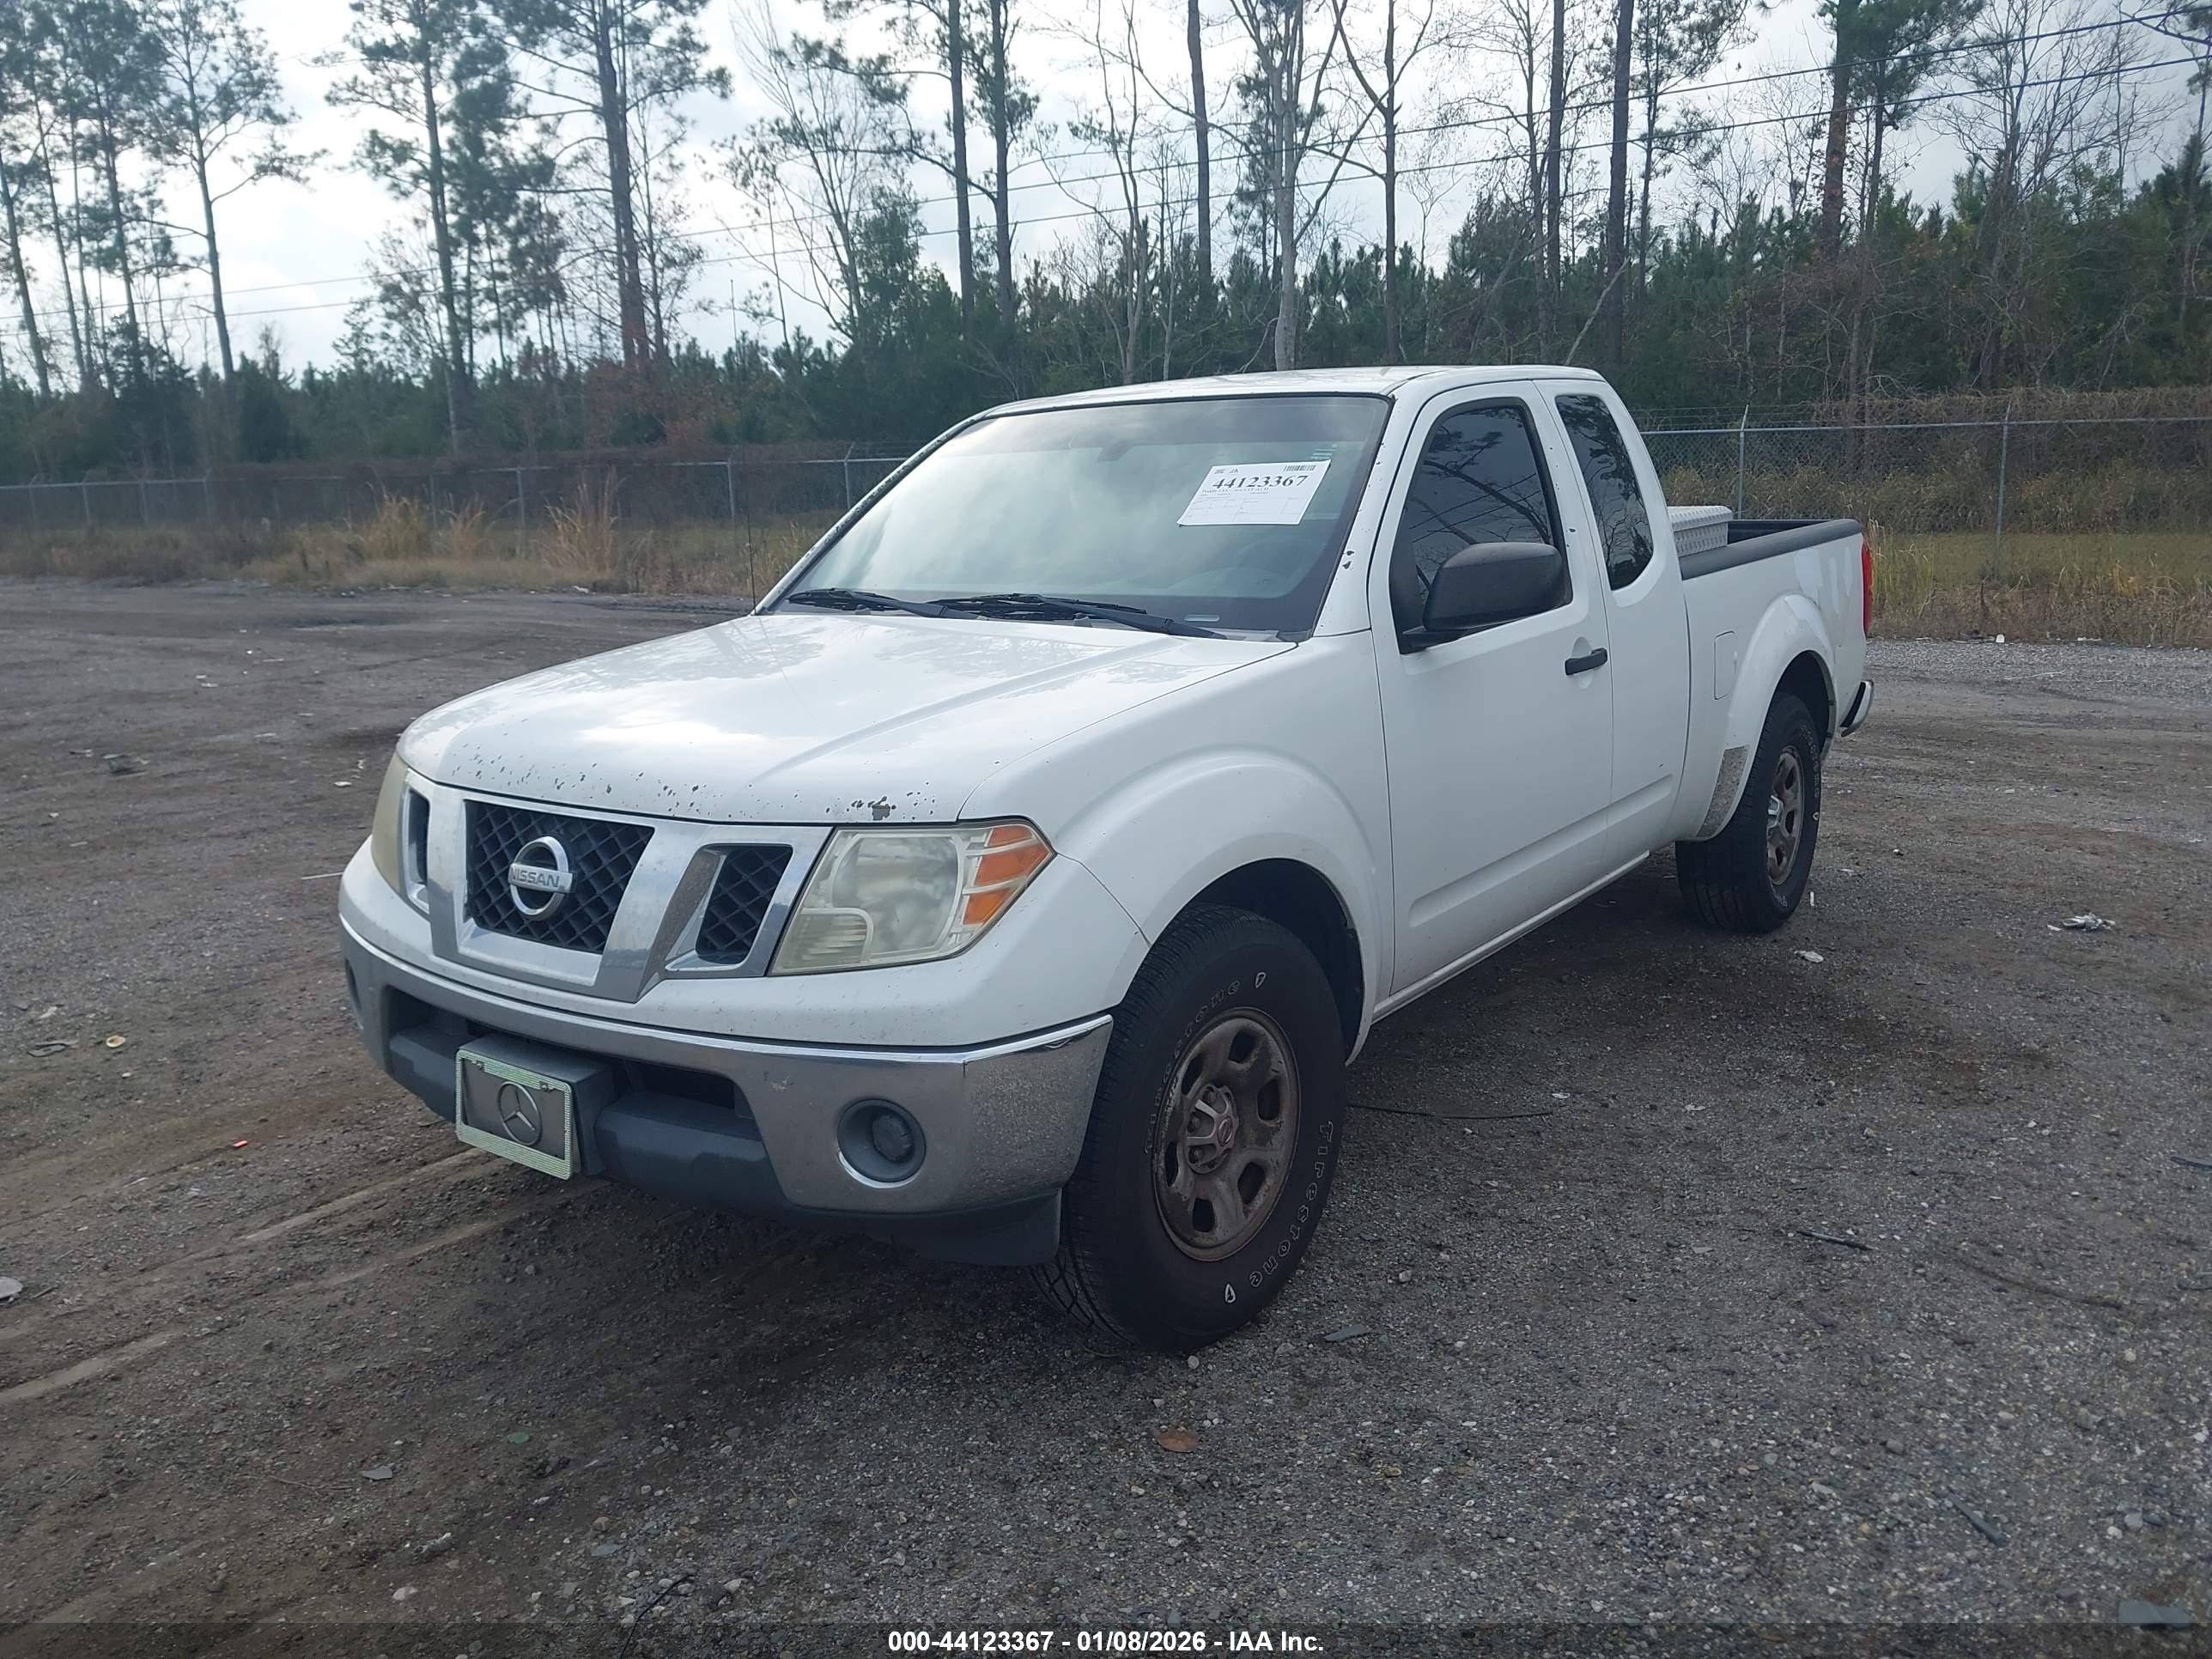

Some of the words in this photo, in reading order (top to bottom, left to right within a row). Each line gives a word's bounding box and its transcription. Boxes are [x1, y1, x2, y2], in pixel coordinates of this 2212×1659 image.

[1212, 475, 1310, 489] 44123367
[510, 866, 560, 888] NISSAN
[1249, 1121, 1334, 1287] Firestone
